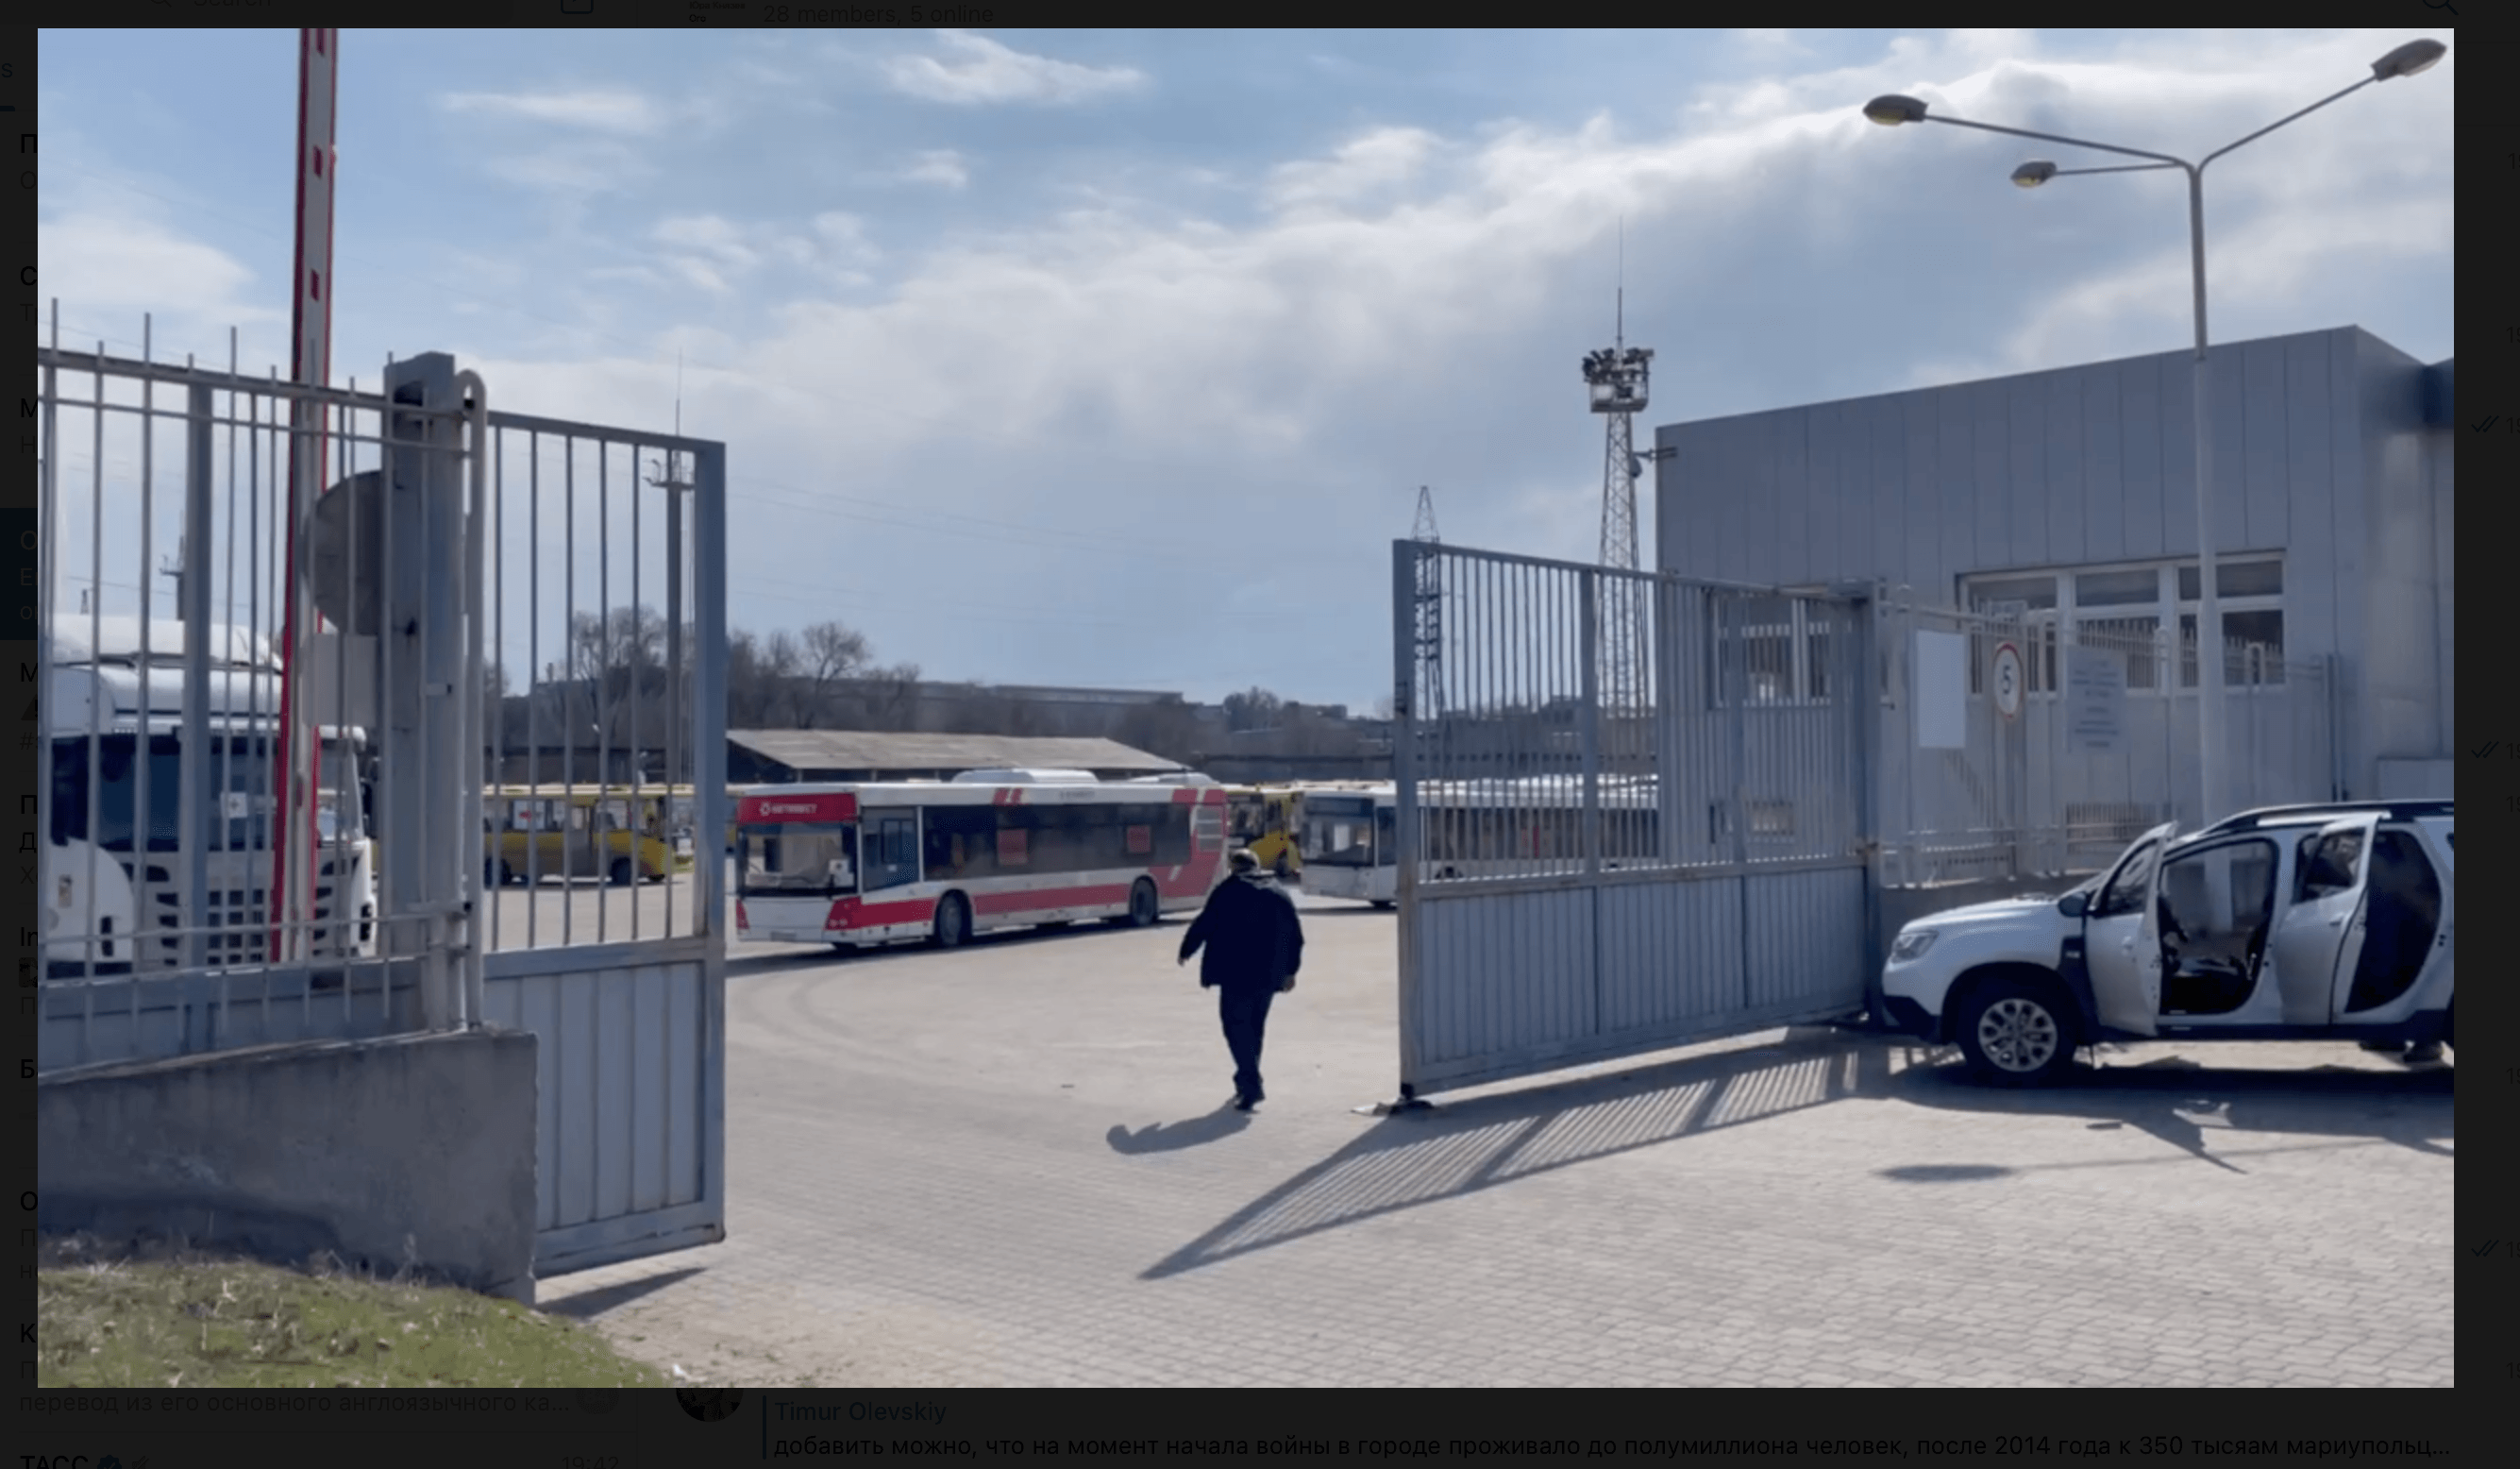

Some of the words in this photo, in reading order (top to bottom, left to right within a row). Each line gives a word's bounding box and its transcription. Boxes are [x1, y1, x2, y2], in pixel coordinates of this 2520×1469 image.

[764, 5, 790, 23] 28
[798, 4, 901, 26] members,
[911, 5, 923, 23] 5
[930, 4, 994, 23] online
[2002, 664, 2012, 695] 5
[20, 1396, 119, 1416] перевод
[126, 1396, 153, 1411] из
[160, 1396, 199, 1411] его
[207, 1396, 331, 1411] основного
[339, 1396, 516, 1415] англоязычного
[774, 1400, 842, 1421] Timur
[848, 1400, 948, 1426] Olevskiy
[773, 1434, 884, 1459] добавить
[892, 1440, 977, 1460] можно,
[985, 1440, 1025, 1455] что
[1033, 1440, 1059, 1455] на
[1067, 1440, 1159, 1455] момент
[1167, 1440, 1249, 1455] начала
[1256, 1434, 1330, 1455] войны
[1338, 1440, 1351, 1455] в
[1358, 1440, 1441, 1460] городе
[1449, 1440, 1581, 1460] проживало
[1587, 1440, 1617, 1459] до
[1624, 1440, 1798, 1460] полумиллиона
[1806, 1440, 1908, 1460] человек,
[1917, 1440, 1987, 1455] после
[1994, 1435, 2051, 1456] 2014
[2058, 1440, 2110, 1459] года
[2119, 1440, 2132, 1455] к
[2139, 1435, 2183, 1456] 350
[2191, 1440, 2278, 1455] тысяам
[19, 1455, 89, 1469] ТАСС
[562, 1456, 619, 1469] 19:42
